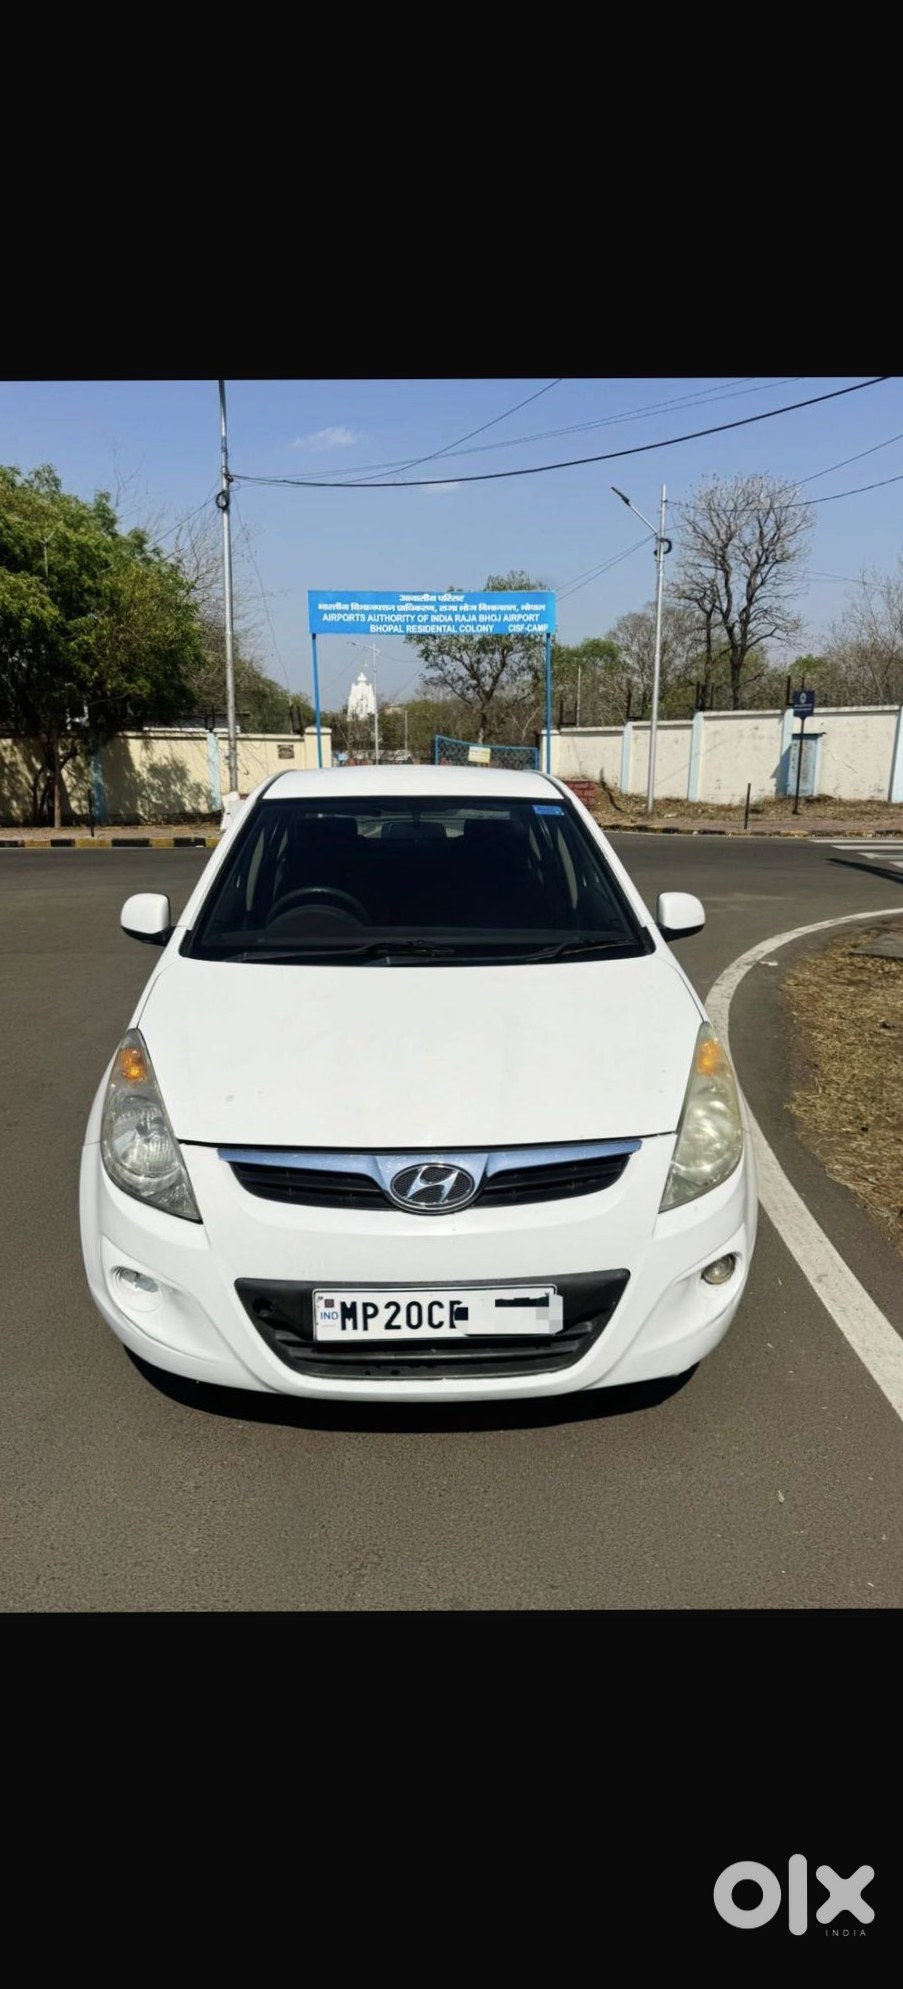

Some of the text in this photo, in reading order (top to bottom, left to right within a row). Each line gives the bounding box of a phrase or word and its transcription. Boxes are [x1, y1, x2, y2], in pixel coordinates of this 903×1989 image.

[438, 594, 464, 602] परिसर
[322, 613, 540, 622] AIRPORTS AUTHORITY OF INDIA RAJA BHOJ AIRPORT
[370, 624, 549, 632] BHOPAL RESIDENTAL COLONY CISF-CAMP
[320, 1312, 339, 1320] IND
